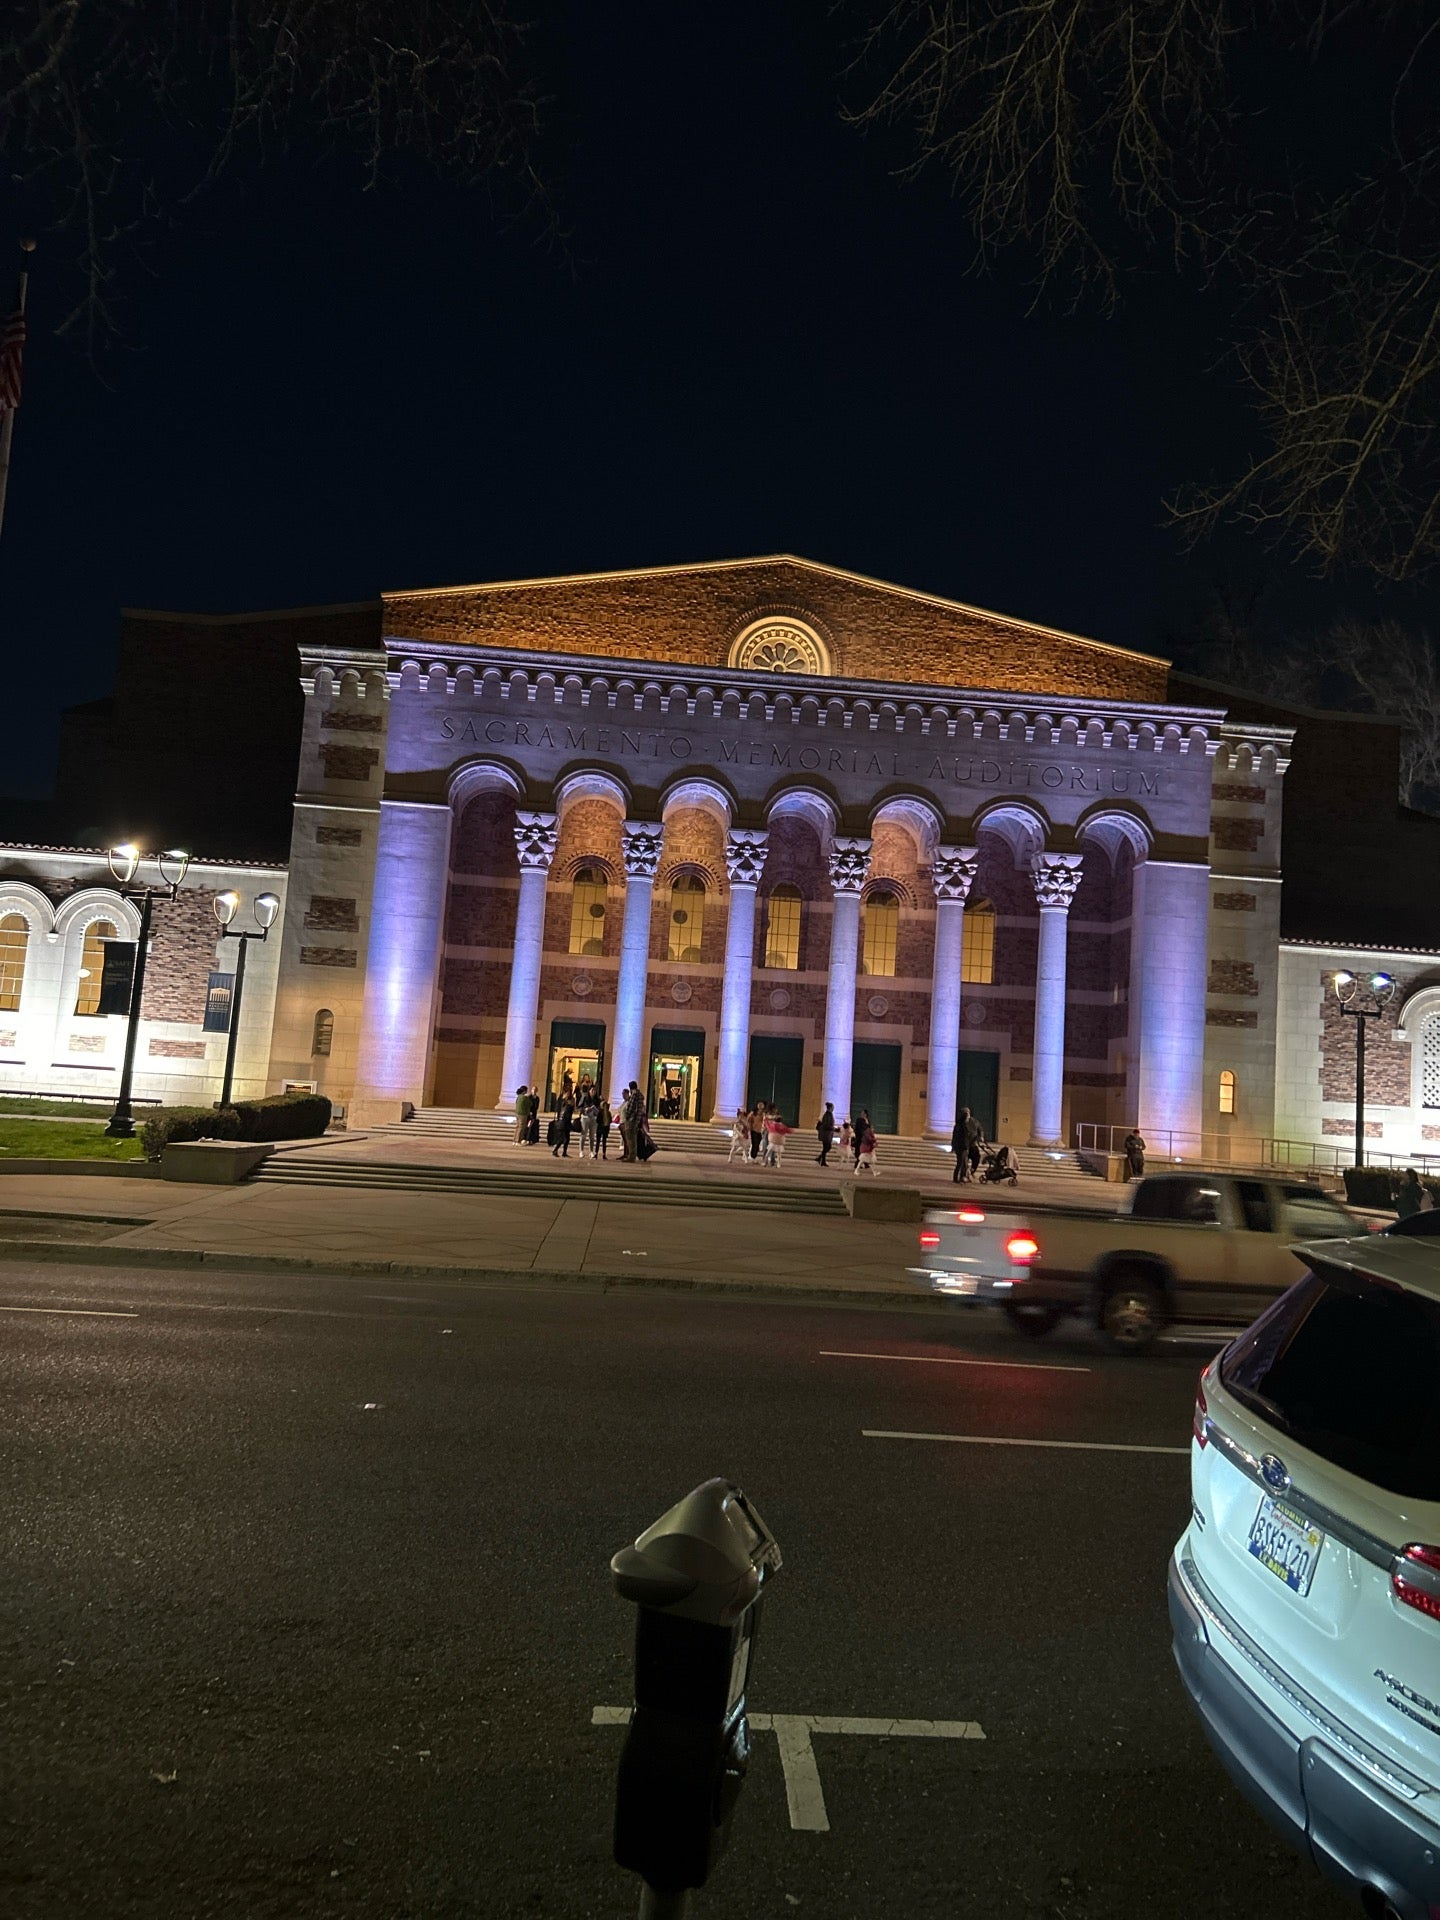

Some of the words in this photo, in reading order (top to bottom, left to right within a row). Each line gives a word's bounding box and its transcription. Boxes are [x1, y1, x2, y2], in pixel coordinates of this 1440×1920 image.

[440, 716, 693, 759] SACRAMENTO
[718, 737, 906, 777] MEMORIAL
[928, 755, 1162, 796] AUDITORIUM
[1276, 1502, 1305, 1528] ALUMNI
[1254, 1516, 1310, 1580] 8SKP120
